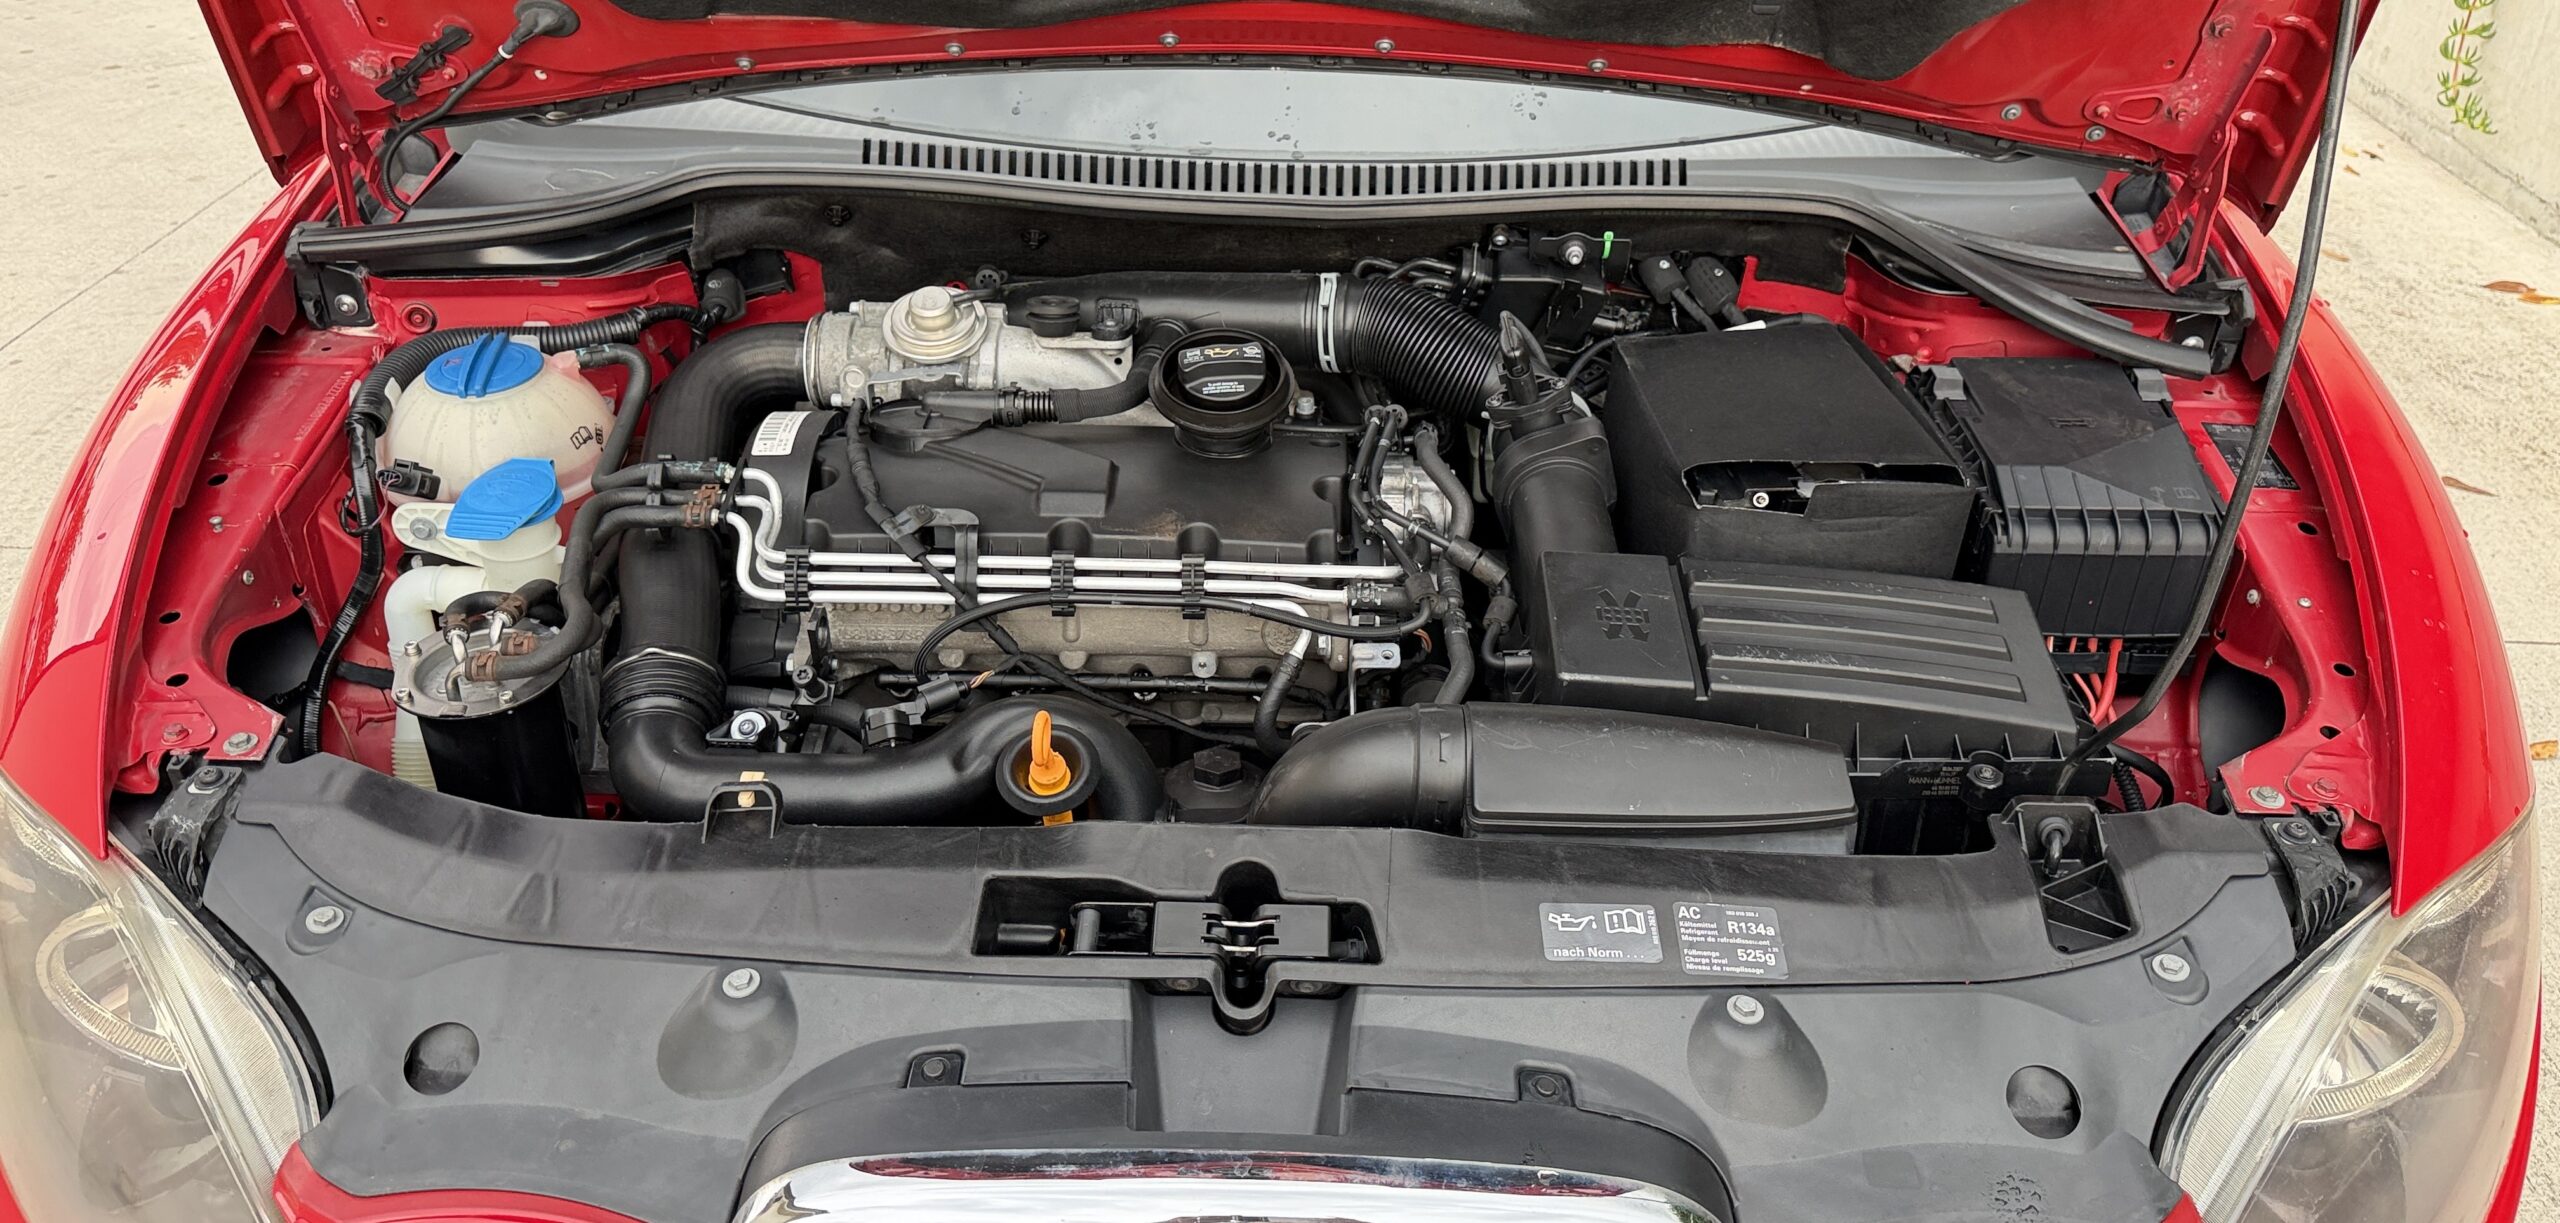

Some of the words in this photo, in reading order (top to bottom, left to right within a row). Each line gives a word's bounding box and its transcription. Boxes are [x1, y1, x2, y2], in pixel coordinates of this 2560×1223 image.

[1678, 905, 1701, 920] AC
[1679, 920, 1717, 929] Kältemittel
[1727, 920, 1776, 937] R134a
[1680, 927, 1719, 937] Refrigerant
[1681, 934, 1705, 943] Moyen
[1706, 935, 1716, 943] de
[1553, 946, 1585, 957] nach
[1587, 946, 1623, 958] Norm
[1683, 948, 1720, 958] Füllmenge
[1737, 948, 1776, 967] 525g
[1685, 955, 1710, 965] Charge
[1711, 957, 1728, 965] level
[1686, 962, 1711, 971] Niveau
[1712, 964, 1722, 972] de
[1722, 966, 1765, 975] remplissage
